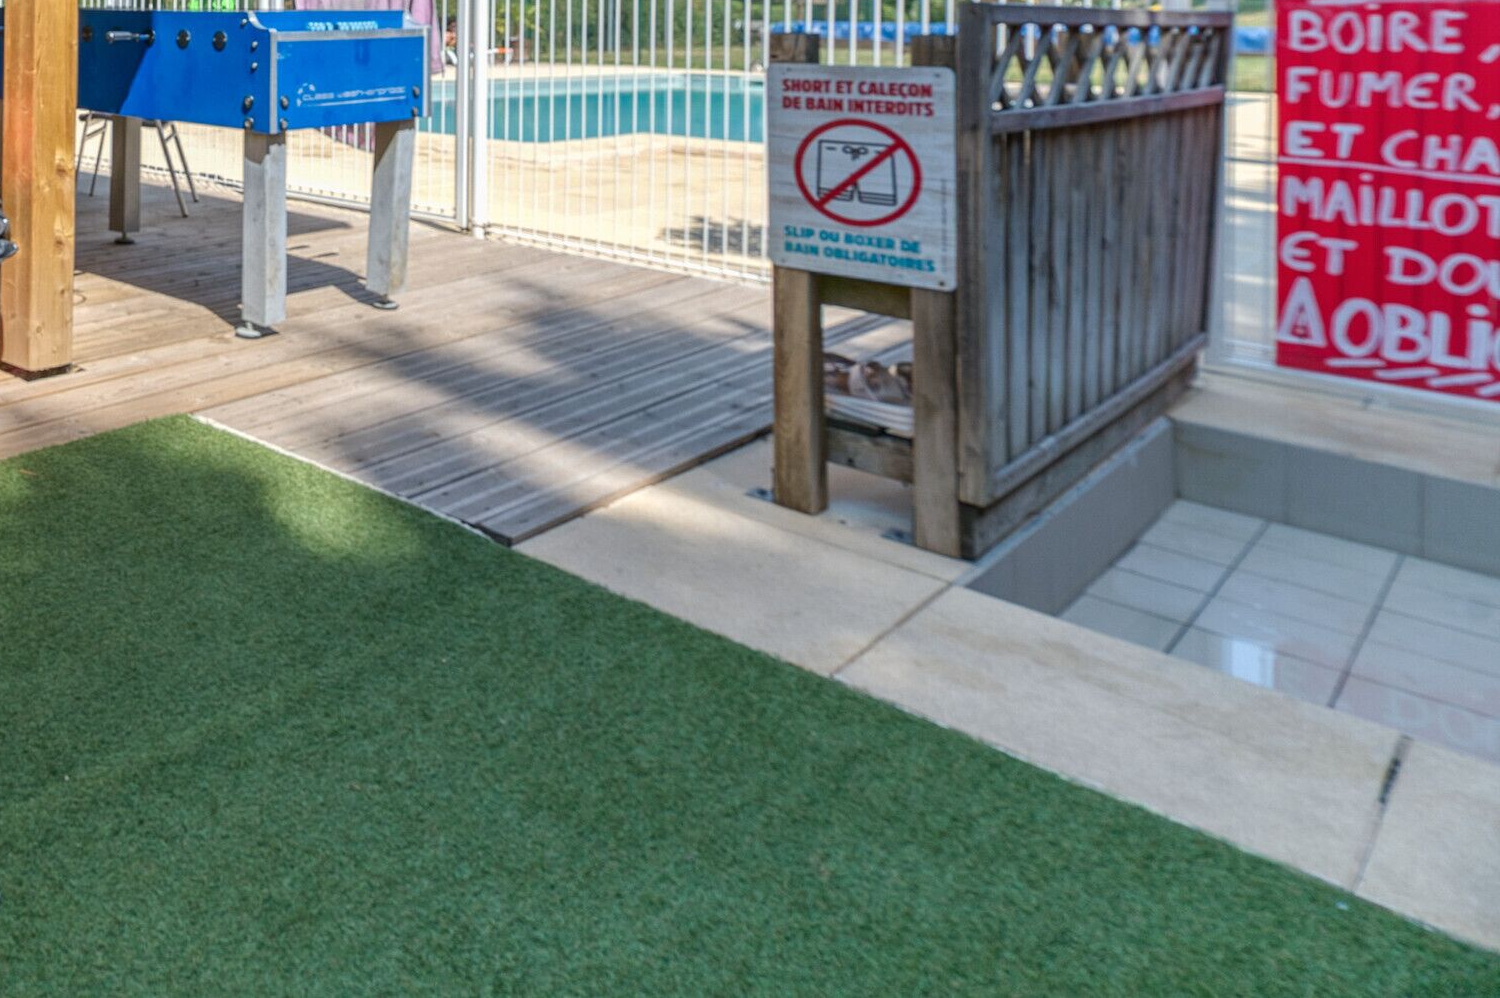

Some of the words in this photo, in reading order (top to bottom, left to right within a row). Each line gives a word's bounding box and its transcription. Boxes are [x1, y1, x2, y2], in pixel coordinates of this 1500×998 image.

[782, 79, 831, 93] SHORT
[836, 80, 853, 94] ET
[858, 81, 932, 99] CALEÇON
[782, 96, 802, 110] DE
[806, 97, 843, 112] BAIN
[848, 99, 934, 117] INTERDITS
[1285, 120, 1364, 159] ET
[784, 225, 815, 240] SLIP
[819, 230, 840, 242] OU
[844, 232, 896, 251] BOXER
[901, 239, 921, 254] DE
[1280, 231, 1359, 276] ET
[784, 240, 819, 257] BAIN
[823, 246, 936, 273] OBLIGATOIRES
